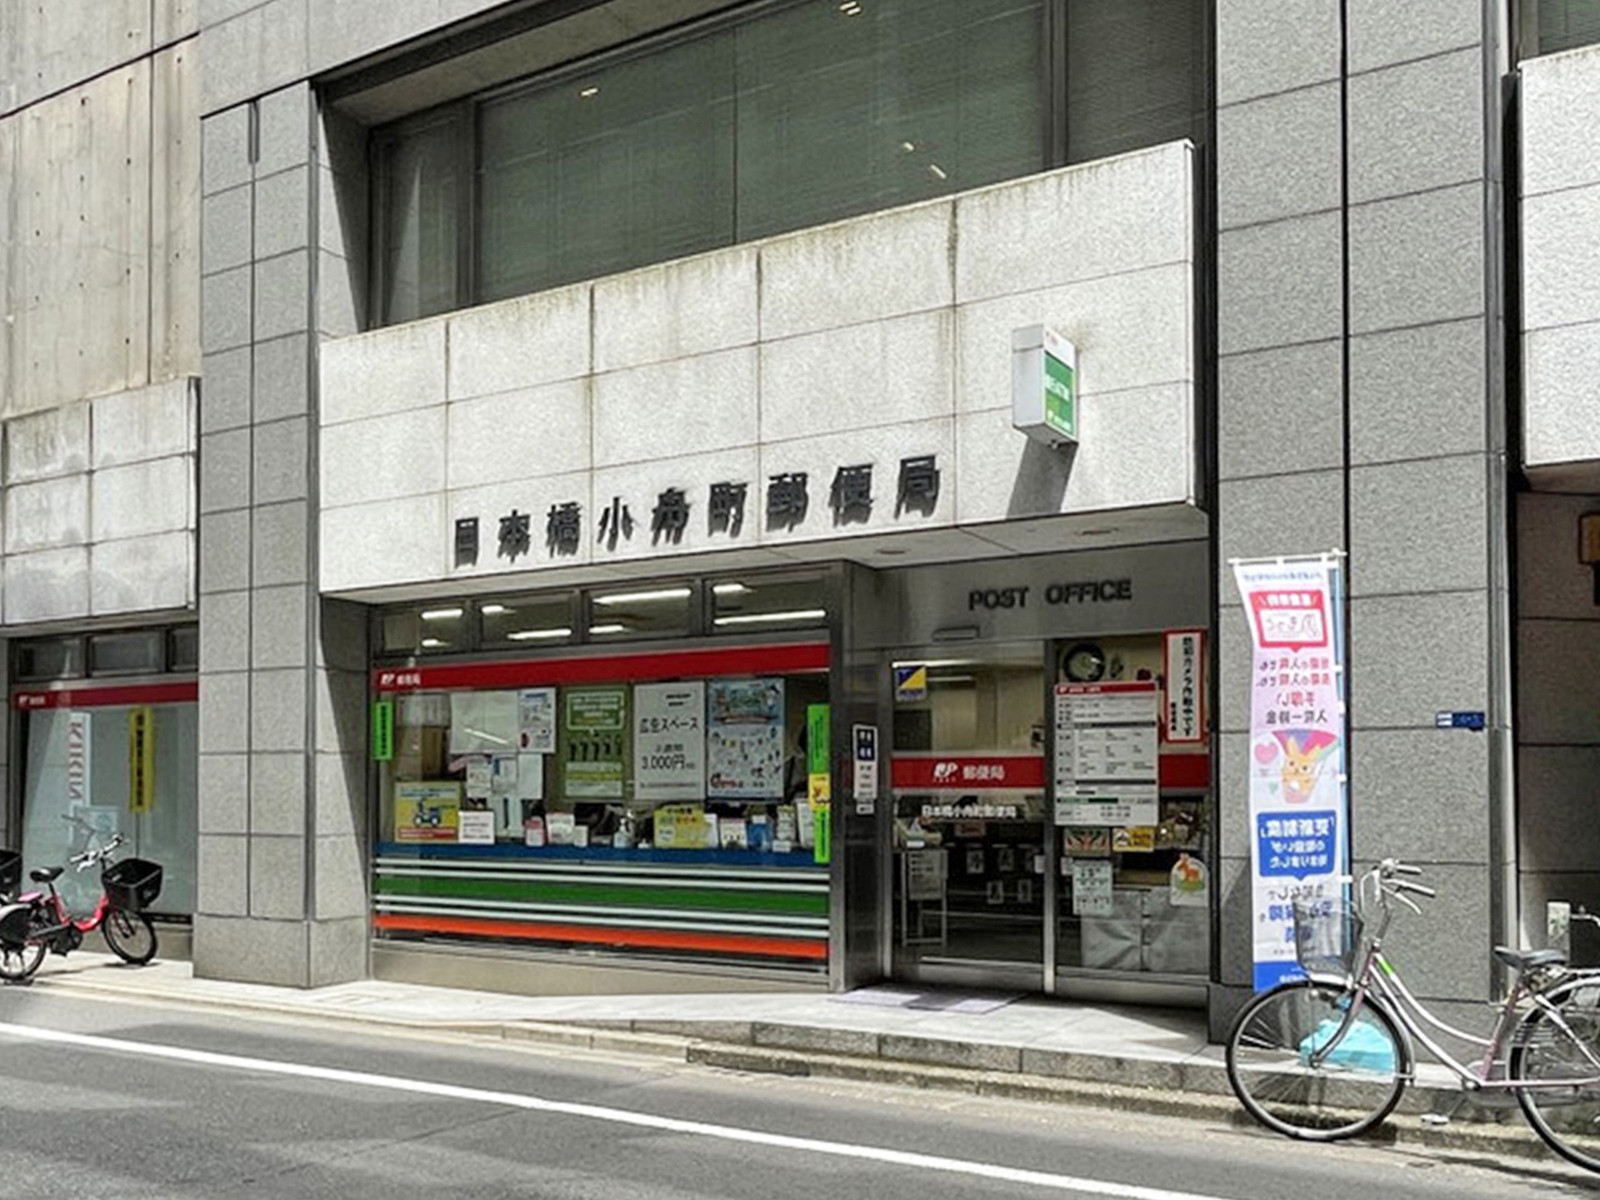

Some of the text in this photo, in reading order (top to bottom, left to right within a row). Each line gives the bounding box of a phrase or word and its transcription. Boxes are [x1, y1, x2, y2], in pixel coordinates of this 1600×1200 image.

[454, 454, 940, 563] 日本橋小舟町郵便局
[968, 579, 1133, 611] POST OFFICE
[963, 764, 1005, 780] 郵便局
